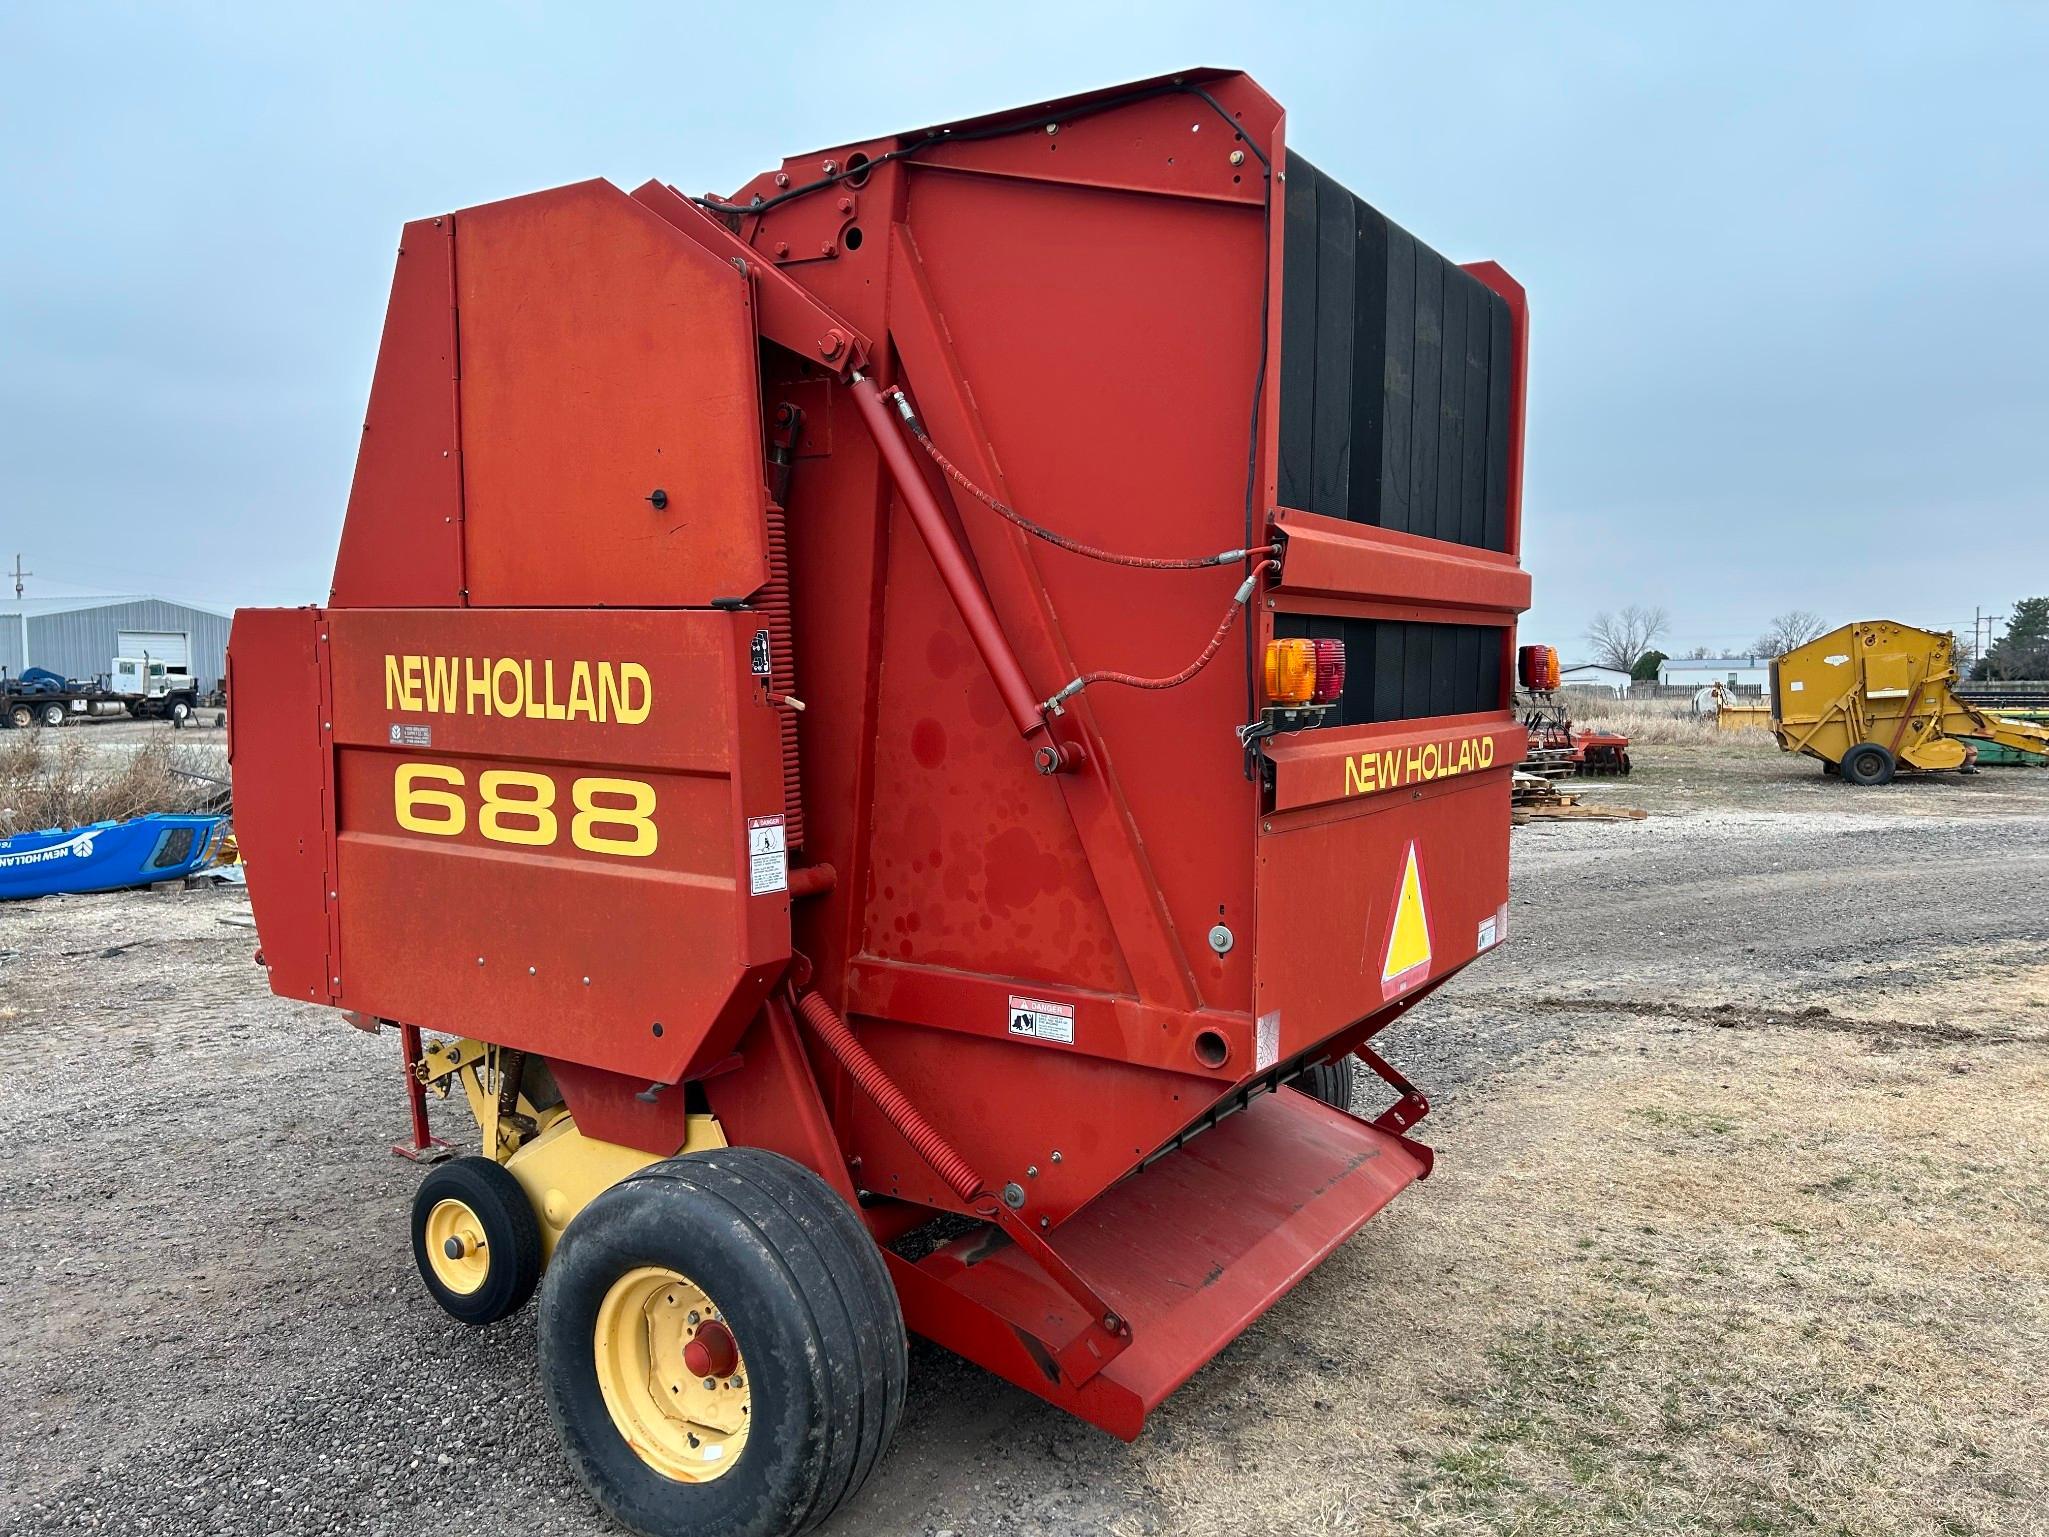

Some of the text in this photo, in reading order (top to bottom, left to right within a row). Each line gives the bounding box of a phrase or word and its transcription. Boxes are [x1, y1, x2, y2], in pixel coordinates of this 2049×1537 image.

[385, 654, 653, 725] NEW HOLLAND
[1345, 736, 1494, 796] NEW HOLLAND
[394, 762, 659, 857] 688
[760, 818, 780, 826] DANGER
[0, 848, 69, 867] NEW HOLLAN
[1031, 1002, 1063, 1014] DANGER
